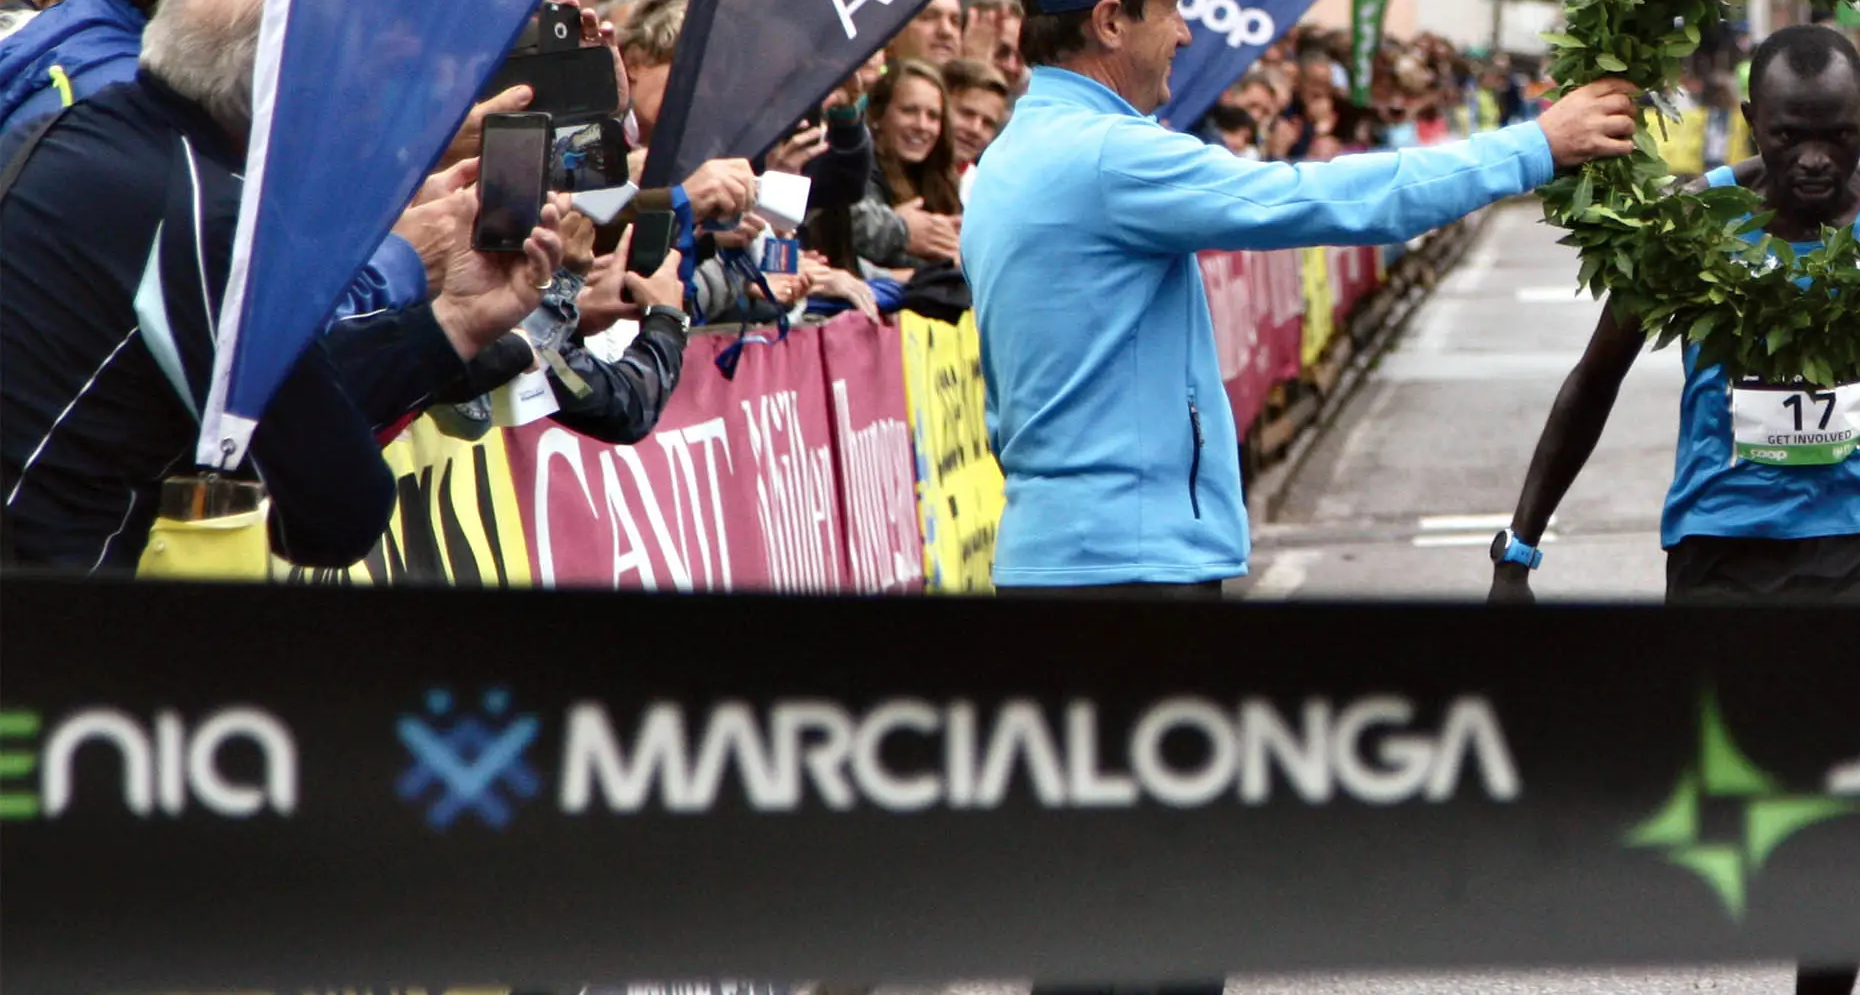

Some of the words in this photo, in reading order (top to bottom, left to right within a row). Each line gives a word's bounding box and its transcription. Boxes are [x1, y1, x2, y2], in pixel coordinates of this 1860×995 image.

[1783, 392, 1836, 432] 17
[1767, 432, 1790, 446] GET
[1793, 429, 1853, 445] INVOLVED
[561, 696, 1524, 814] MARCIALONGA
